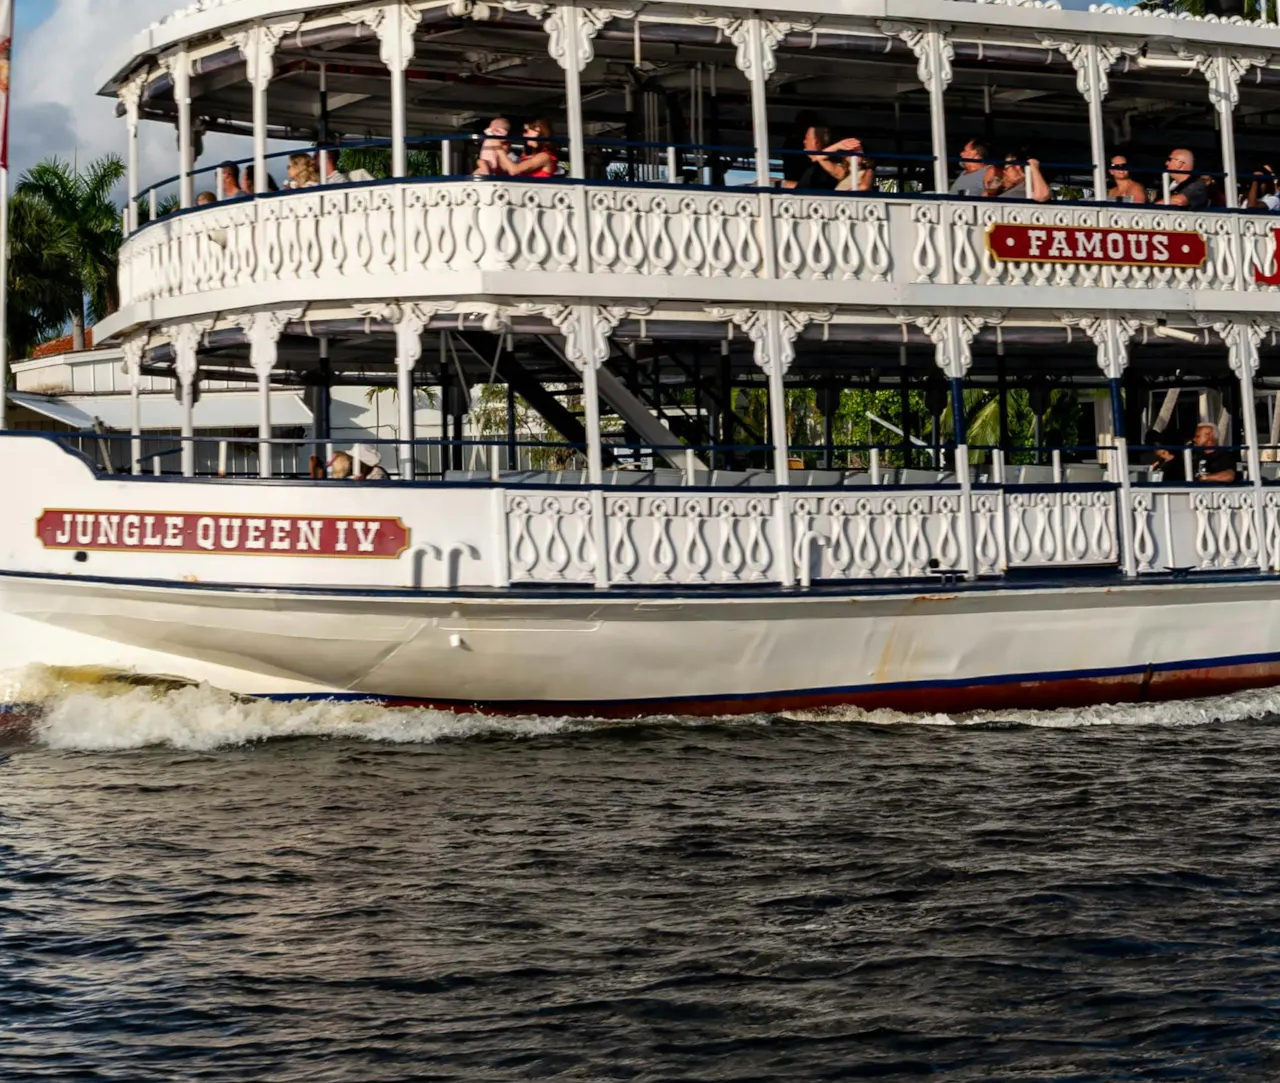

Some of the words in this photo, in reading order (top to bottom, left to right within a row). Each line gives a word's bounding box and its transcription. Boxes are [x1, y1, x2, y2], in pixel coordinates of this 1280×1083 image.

[1027, 229, 1171, 261] FAMOUS
[55, 513, 185, 547] JUNGLE
[195, 516, 324, 551] QUEEN
[334, 519, 382, 552] IV
